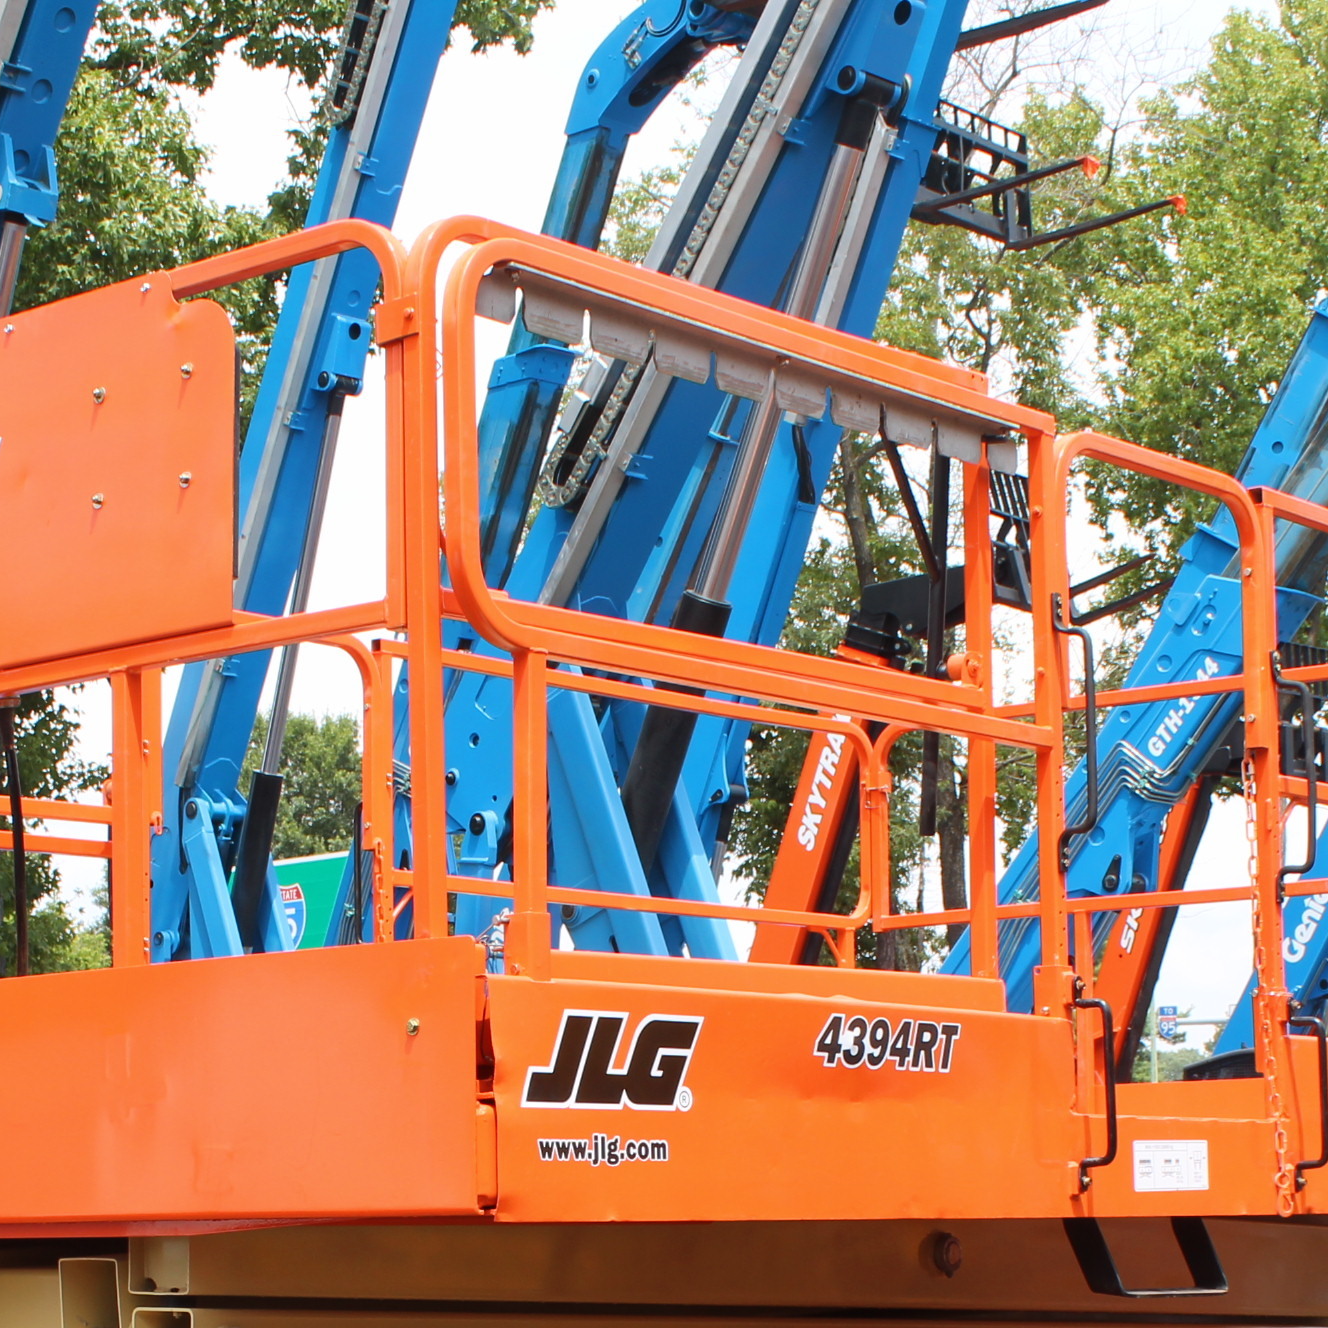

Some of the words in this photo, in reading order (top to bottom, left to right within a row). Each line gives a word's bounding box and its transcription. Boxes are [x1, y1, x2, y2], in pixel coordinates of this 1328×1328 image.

[797, 713, 852, 851] SKYTRA
[1160, 1020, 1176, 1035] 95
[1164, 1007, 1174, 1015] TO
[520, 1009, 704, 1112] JLG
[813, 1013, 961, 1072] 4394RT
[537, 1134, 669, 1167] www.jlg.com
